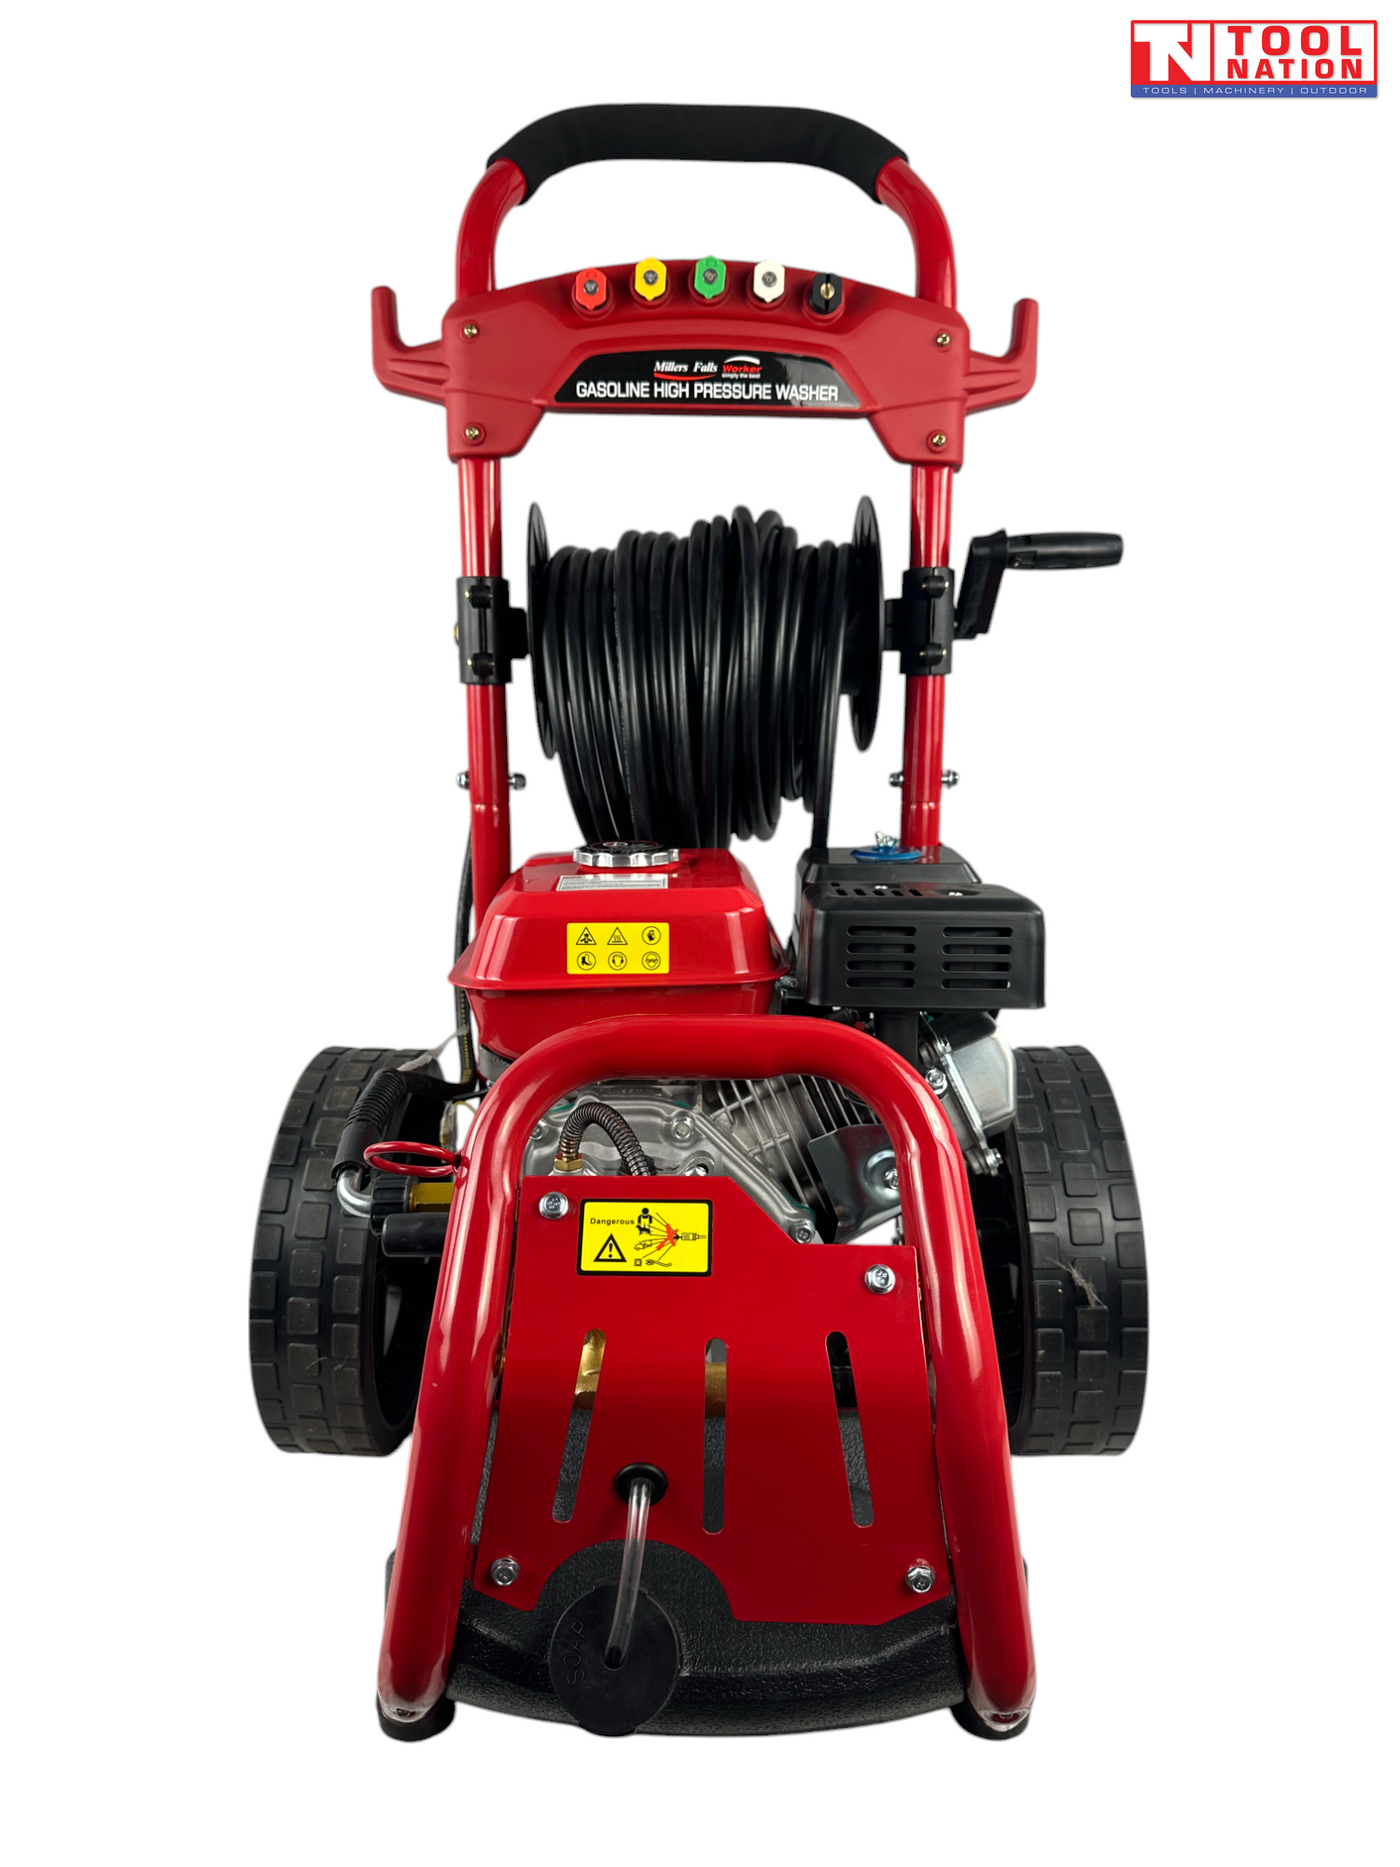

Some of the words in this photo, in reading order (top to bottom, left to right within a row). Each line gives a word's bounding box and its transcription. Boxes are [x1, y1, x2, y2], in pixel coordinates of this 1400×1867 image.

[653, 361, 689, 373] Millers
[693, 361, 719, 373] Falls
[722, 364, 762, 374] Worker
[576, 381, 650, 398] GASOLINE
[653, 382, 690, 399] HIGH
[693, 383, 772, 400] PRESSURE
[775, 384, 839, 401] WASHER
[590, 1217, 635, 1226] Dangerous
[563, 1621, 586, 1685] SOAP
